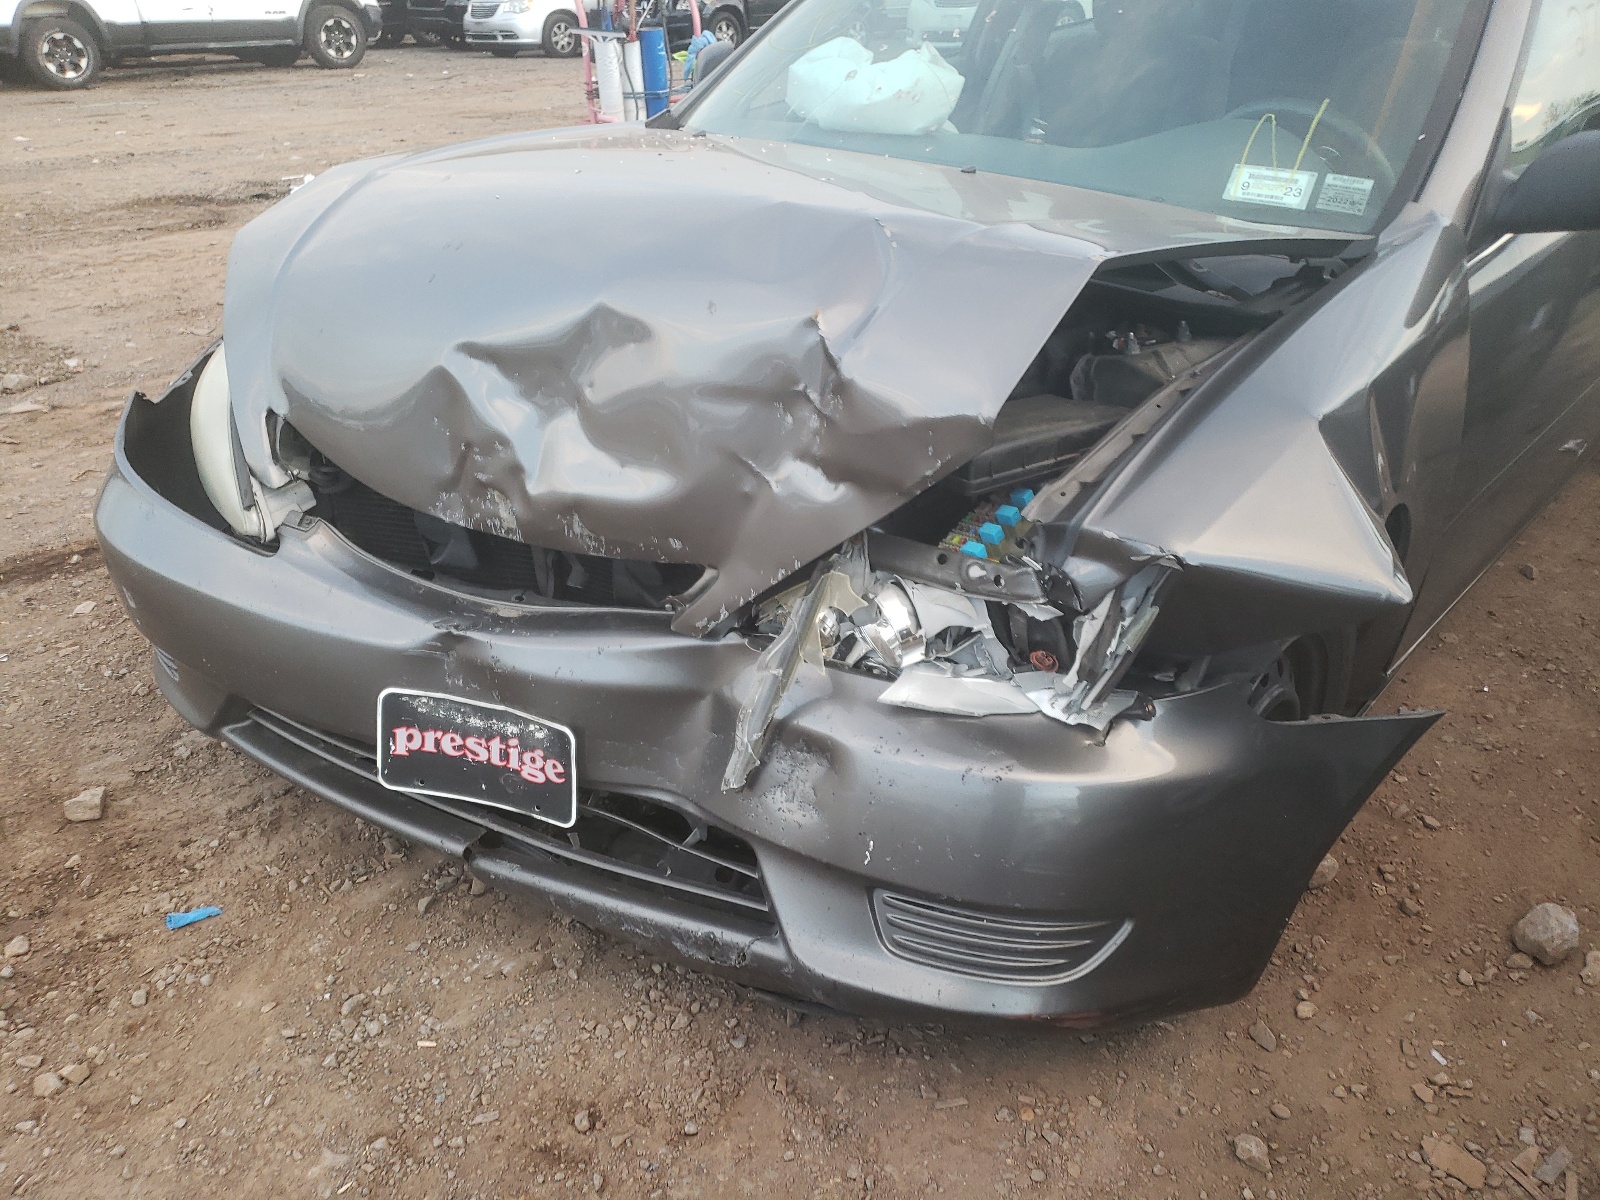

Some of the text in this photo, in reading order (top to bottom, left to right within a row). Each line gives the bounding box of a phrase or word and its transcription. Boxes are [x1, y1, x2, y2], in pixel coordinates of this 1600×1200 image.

[1240, 181, 1251, 191] 9
[1285, 186, 1303, 198] 23
[392, 725, 566, 784] prestige
